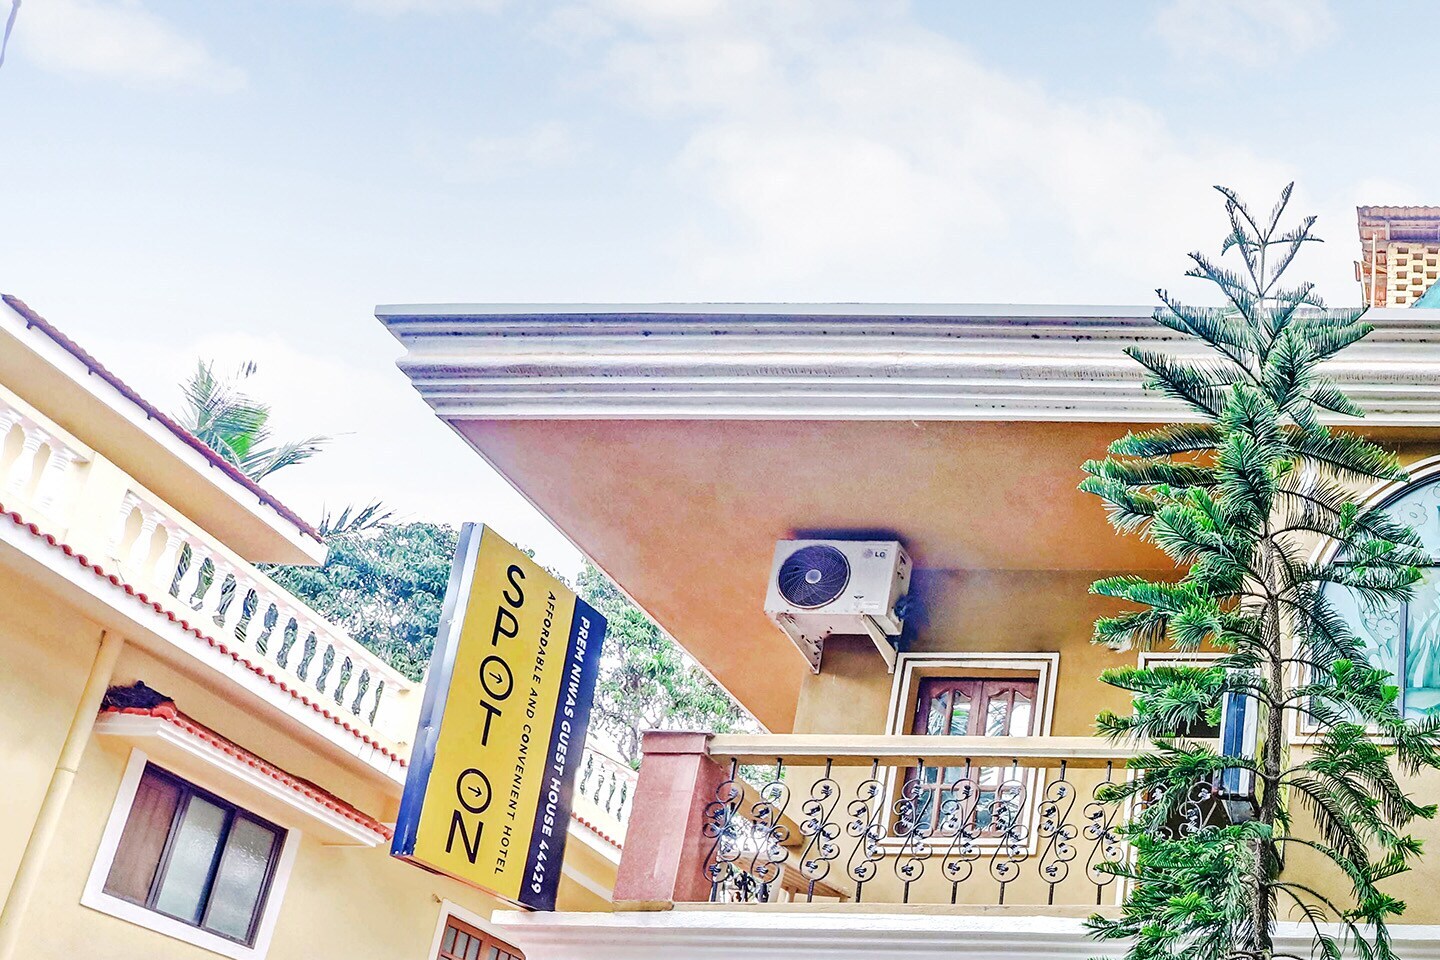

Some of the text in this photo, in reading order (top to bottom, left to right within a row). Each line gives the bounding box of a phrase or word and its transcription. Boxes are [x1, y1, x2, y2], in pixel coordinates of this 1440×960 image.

[445, 564, 526, 865] SPOT ON
[494, 591, 556, 875] AFFORDABLE AND CONVENIENT HOTEL
[531, 616, 591, 894] PREM NIWAS GUEST HOUSE 44429
